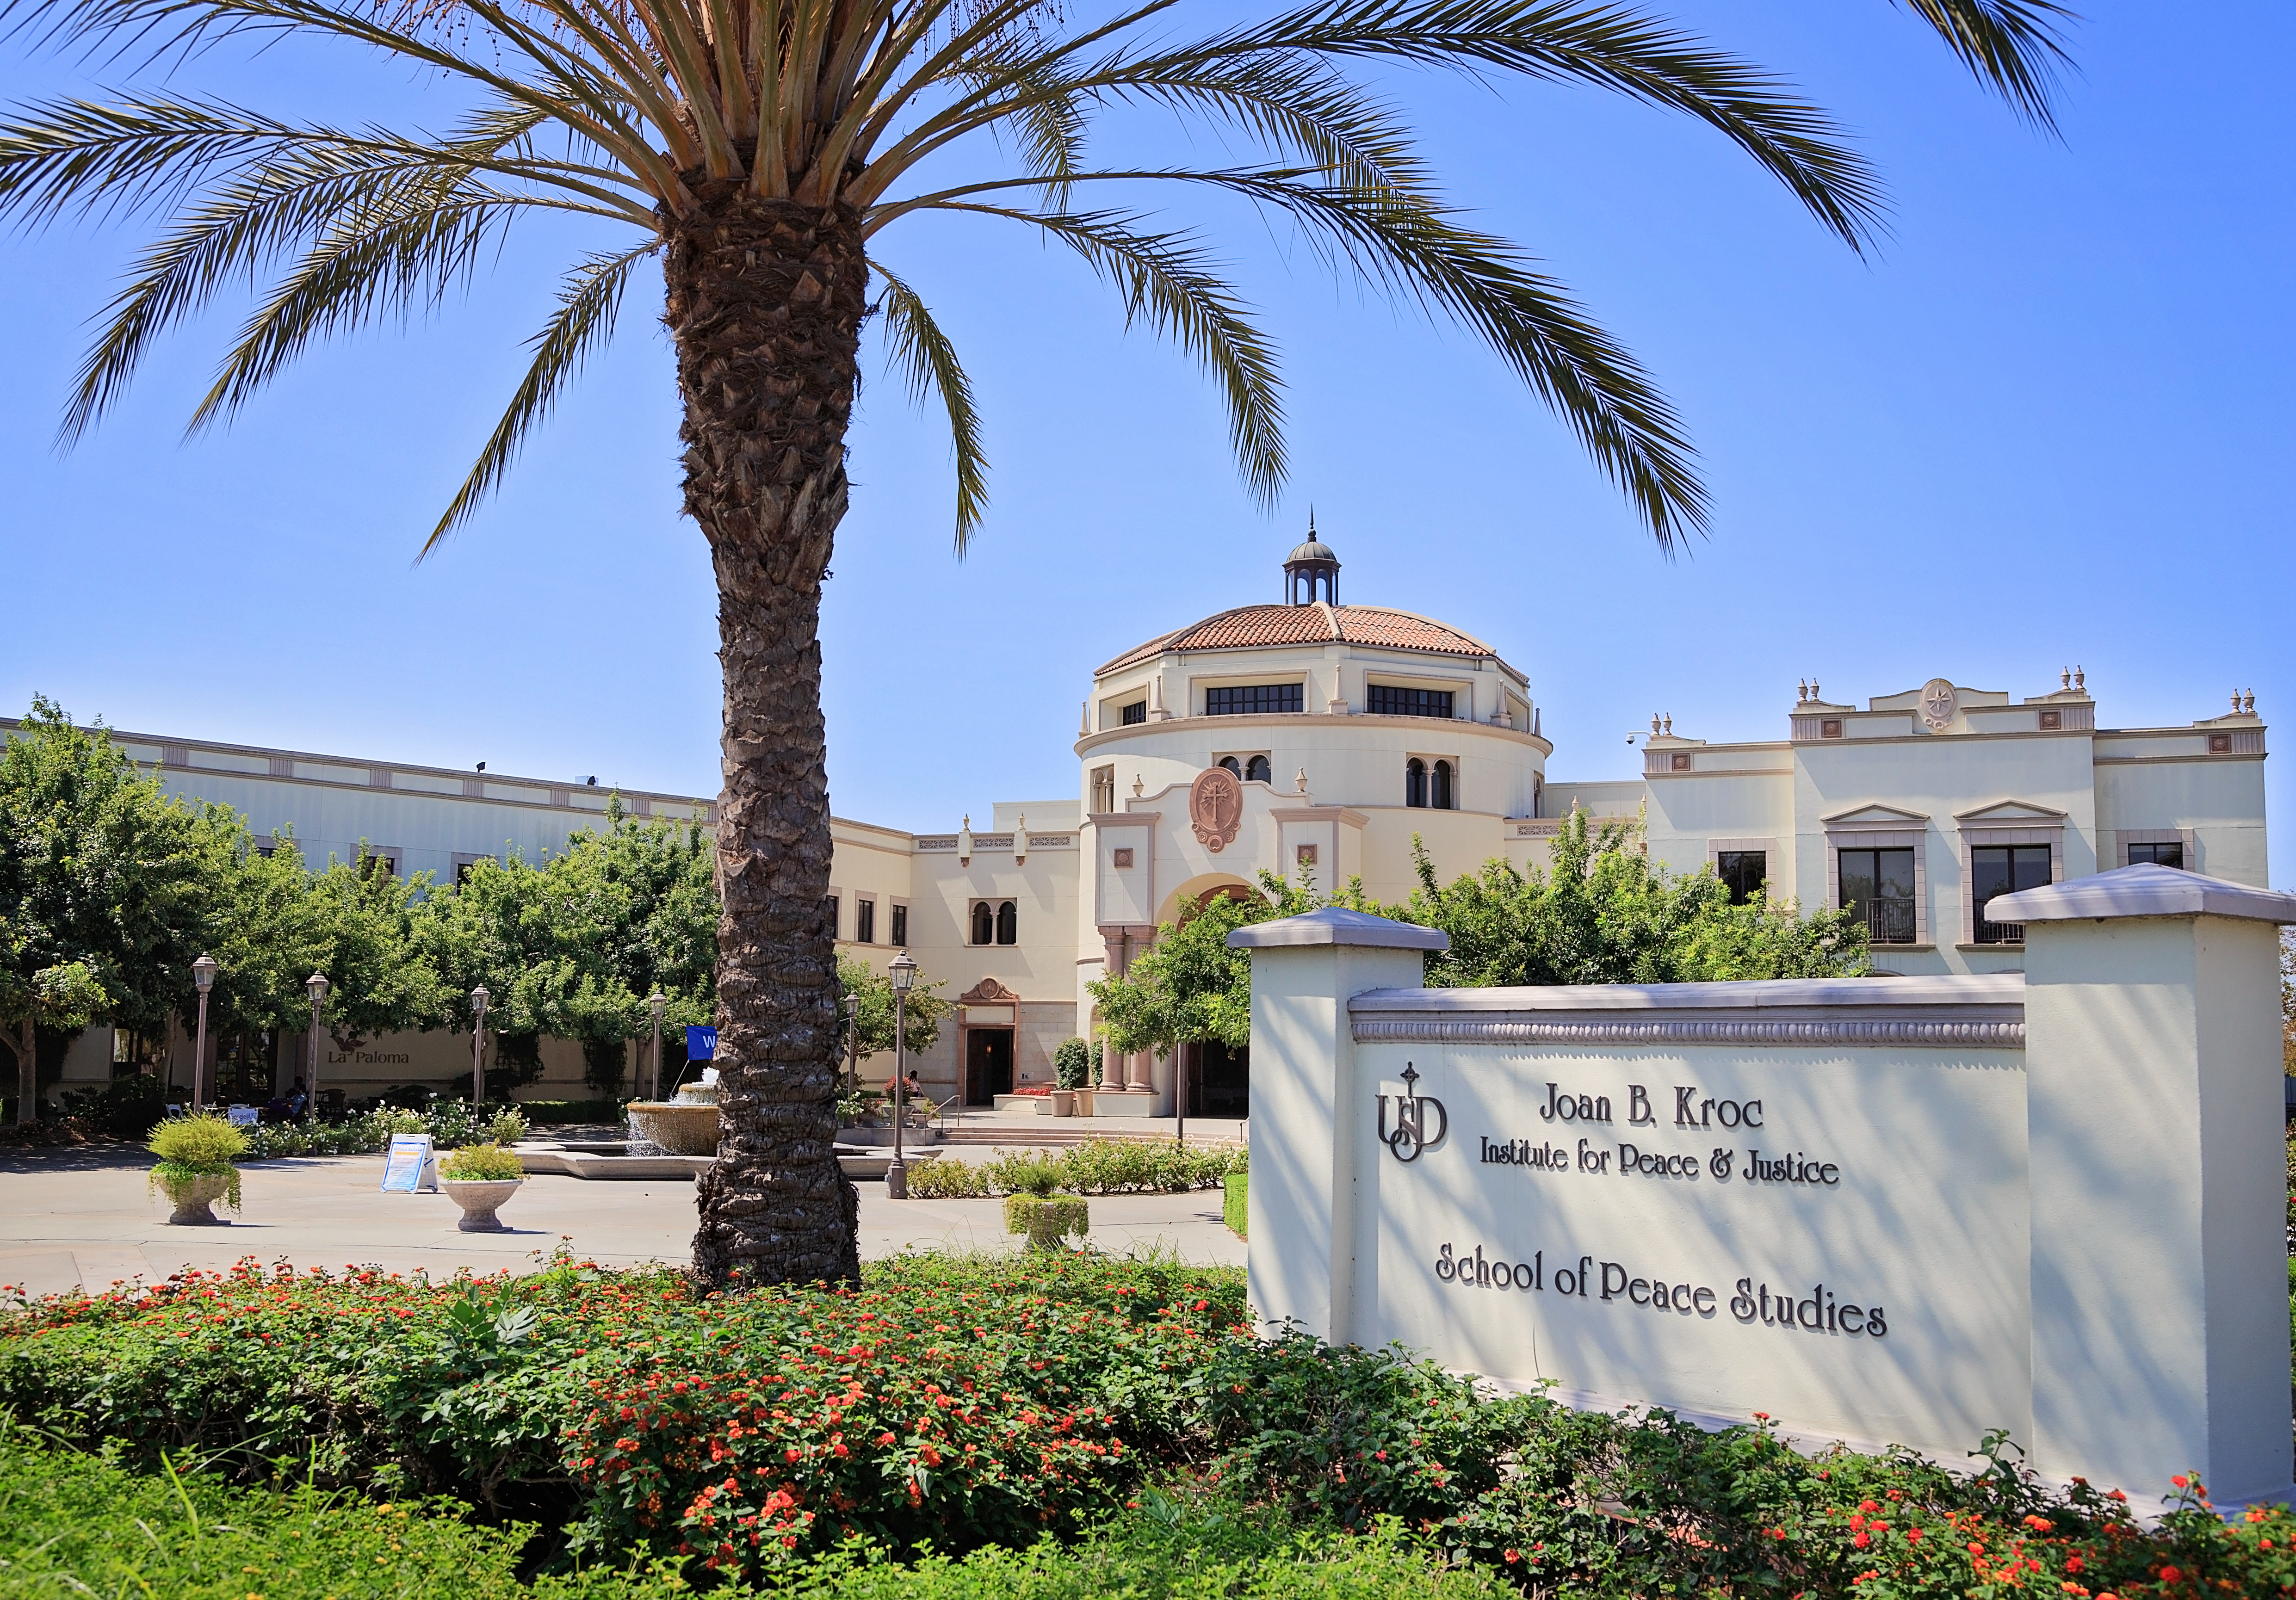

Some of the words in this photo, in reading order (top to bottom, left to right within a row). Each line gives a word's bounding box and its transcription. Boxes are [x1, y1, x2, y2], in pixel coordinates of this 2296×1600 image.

[328, 1051, 346, 1063] La
[356, 1050, 409, 1063] Paloma
[1540, 1083, 1612, 1121] Joan
[1628, 1085, 1656, 1123] B.
[1674, 1086, 1763, 1128] Kroc
[1480, 1136, 1568, 1168] Institute
[1577, 1138, 1610, 1170] for
[1618, 1143, 1698, 1176] Peace
[1709, 1148, 1733, 1178] &
[1743, 1150, 1839, 1184] Justice
[1436, 1242, 1543, 1290] School
[1554, 1256, 1591, 1296] of
[1599, 1262, 1716, 1313] Peace
[1730, 1277, 1887, 1337] Studies
